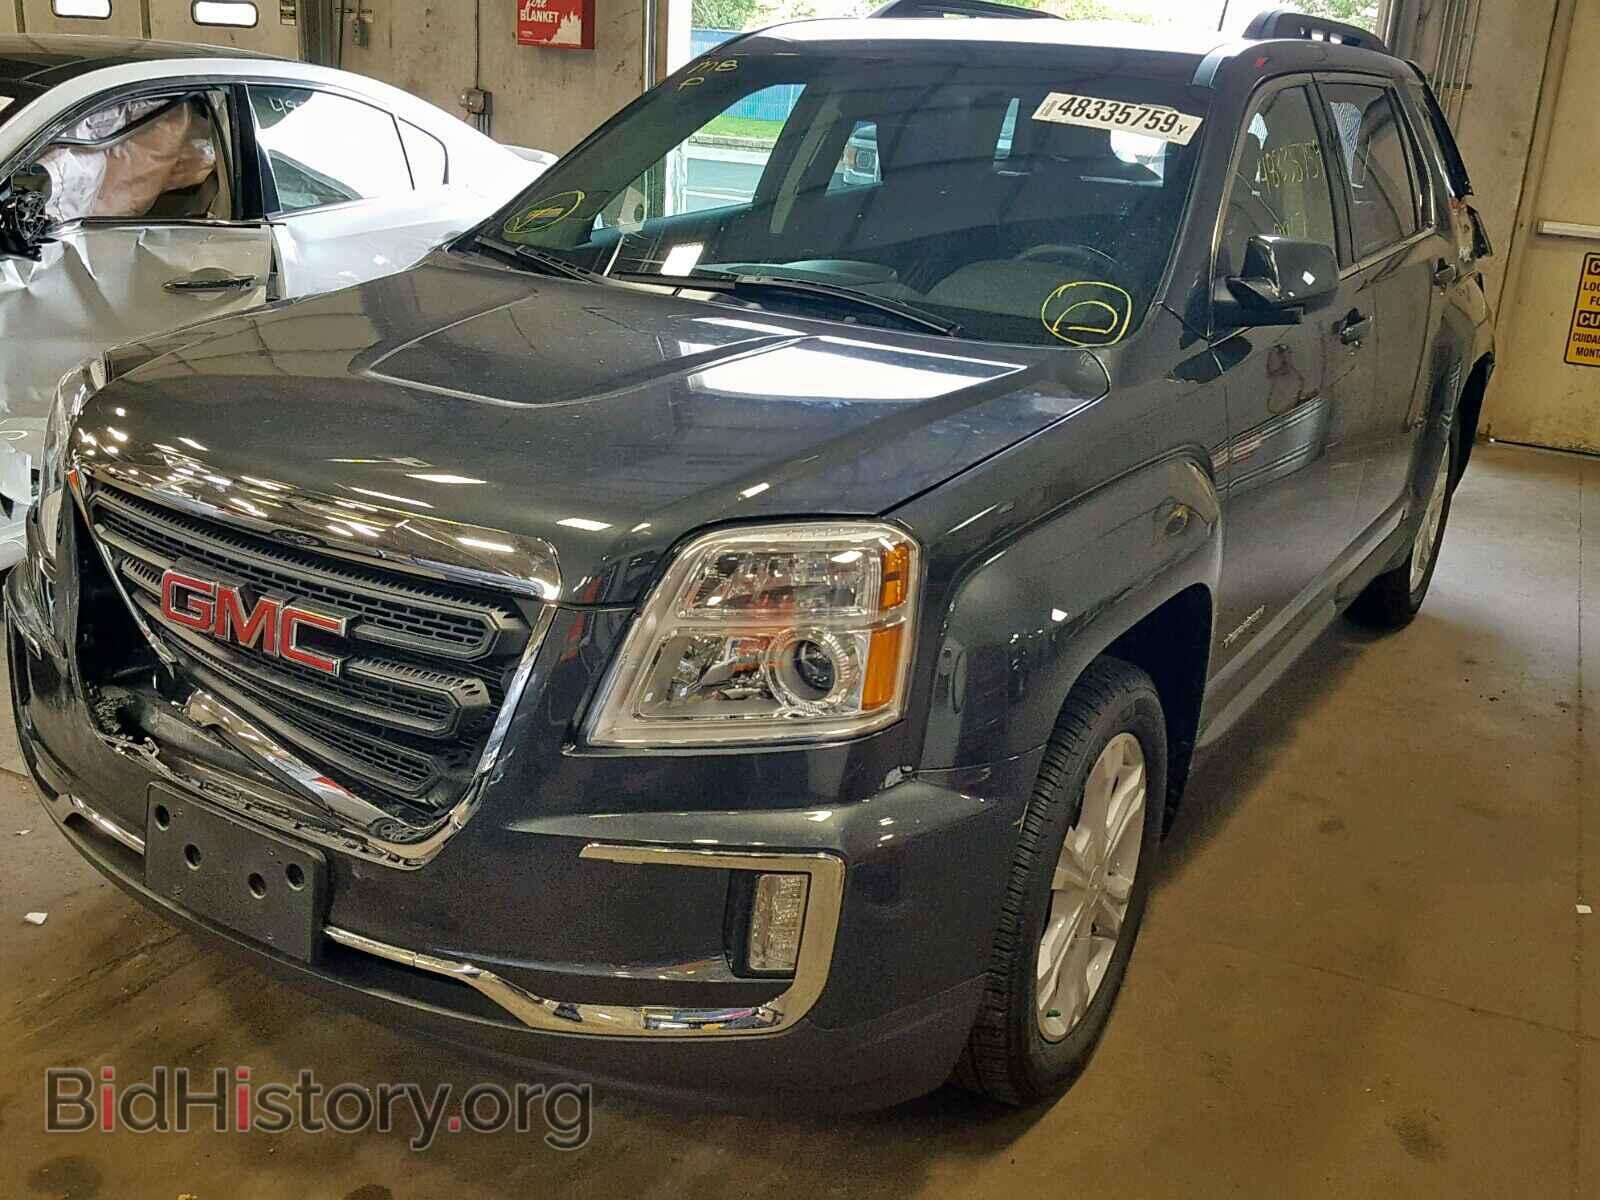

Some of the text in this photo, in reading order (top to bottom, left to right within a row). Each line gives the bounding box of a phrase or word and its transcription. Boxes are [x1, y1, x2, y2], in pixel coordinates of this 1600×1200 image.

[519, 8, 560, 24] BLANKET
[1057, 96, 1180, 133] 48335759
[162, 568, 346, 677] GMC
